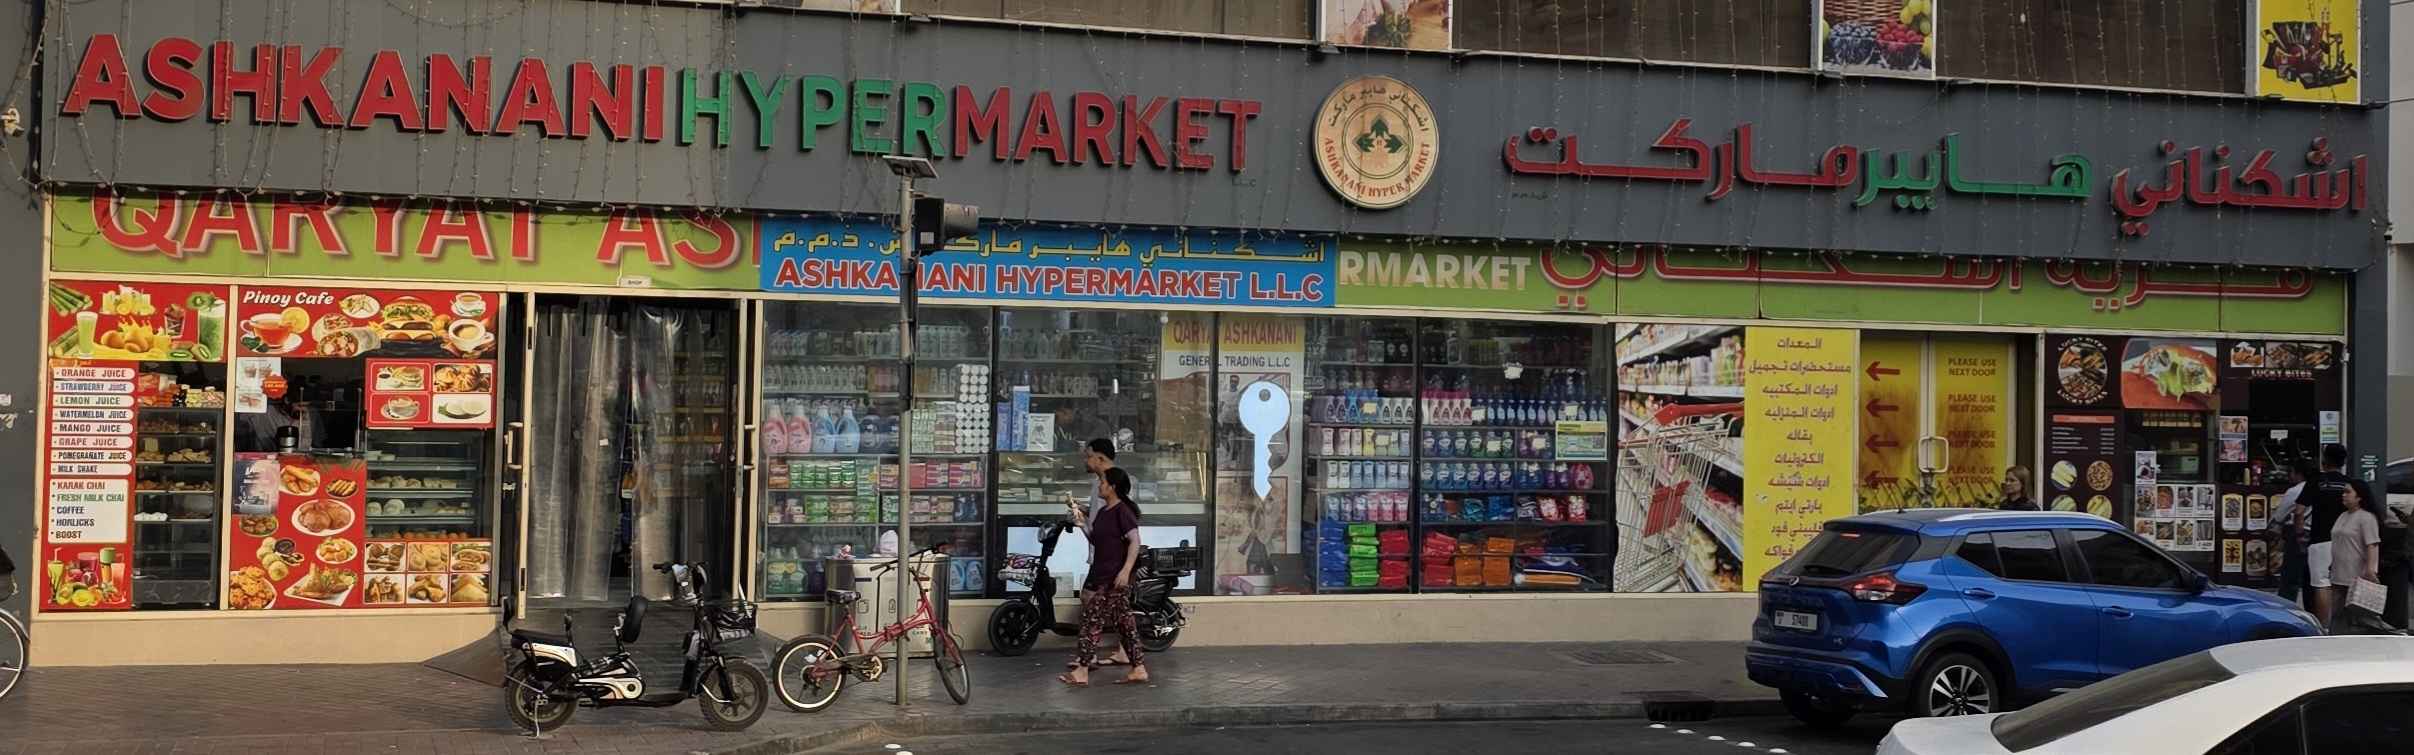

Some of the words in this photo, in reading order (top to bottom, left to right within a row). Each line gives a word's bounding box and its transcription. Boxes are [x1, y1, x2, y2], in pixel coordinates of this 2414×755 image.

[1324, 137, 1368, 196] ASHKANANI
[2110, 136, 2368, 236] اشكناني
[596, 204, 761, 268] AS
[943, 228, 1022, 257] مارك
[1028, 234, 1132, 263] هايبر
[1139, 235, 1326, 268] اشكناني
[995, 262, 1243, 300] HYPERMARKET
[1249, 271, 1326, 302] L.L.C
[242, 290, 292, 308] Pinoy
[294, 291, 335, 305] Cafe
[1173, 320, 1211, 345] QARY
[1223, 319, 1297, 345] ASHKANANI
[1223, 355, 1266, 367] TRADING
[1948, 357, 1977, 366] PLEASE
[1980, 358, 1997, 367] USE
[61, 368, 97, 378] ORANGE
[101, 368, 127, 378] JUICE
[1948, 367, 1970, 376] NEXT
[1971, 368, 1996, 377] DOOR
[2251, 369, 2282, 377] LUCKY
[60, 396, 90, 405] LEMON
[95, 396, 121, 405] JUICE
[59, 423, 91, 433] MANGO
[96, 423, 121, 433] JUICE
[58, 437, 88, 446] GRAPE
[92, 437, 118, 446] JUICE
[56, 506, 85, 514] COFFEE
[55, 530, 83, 539] BOOST
